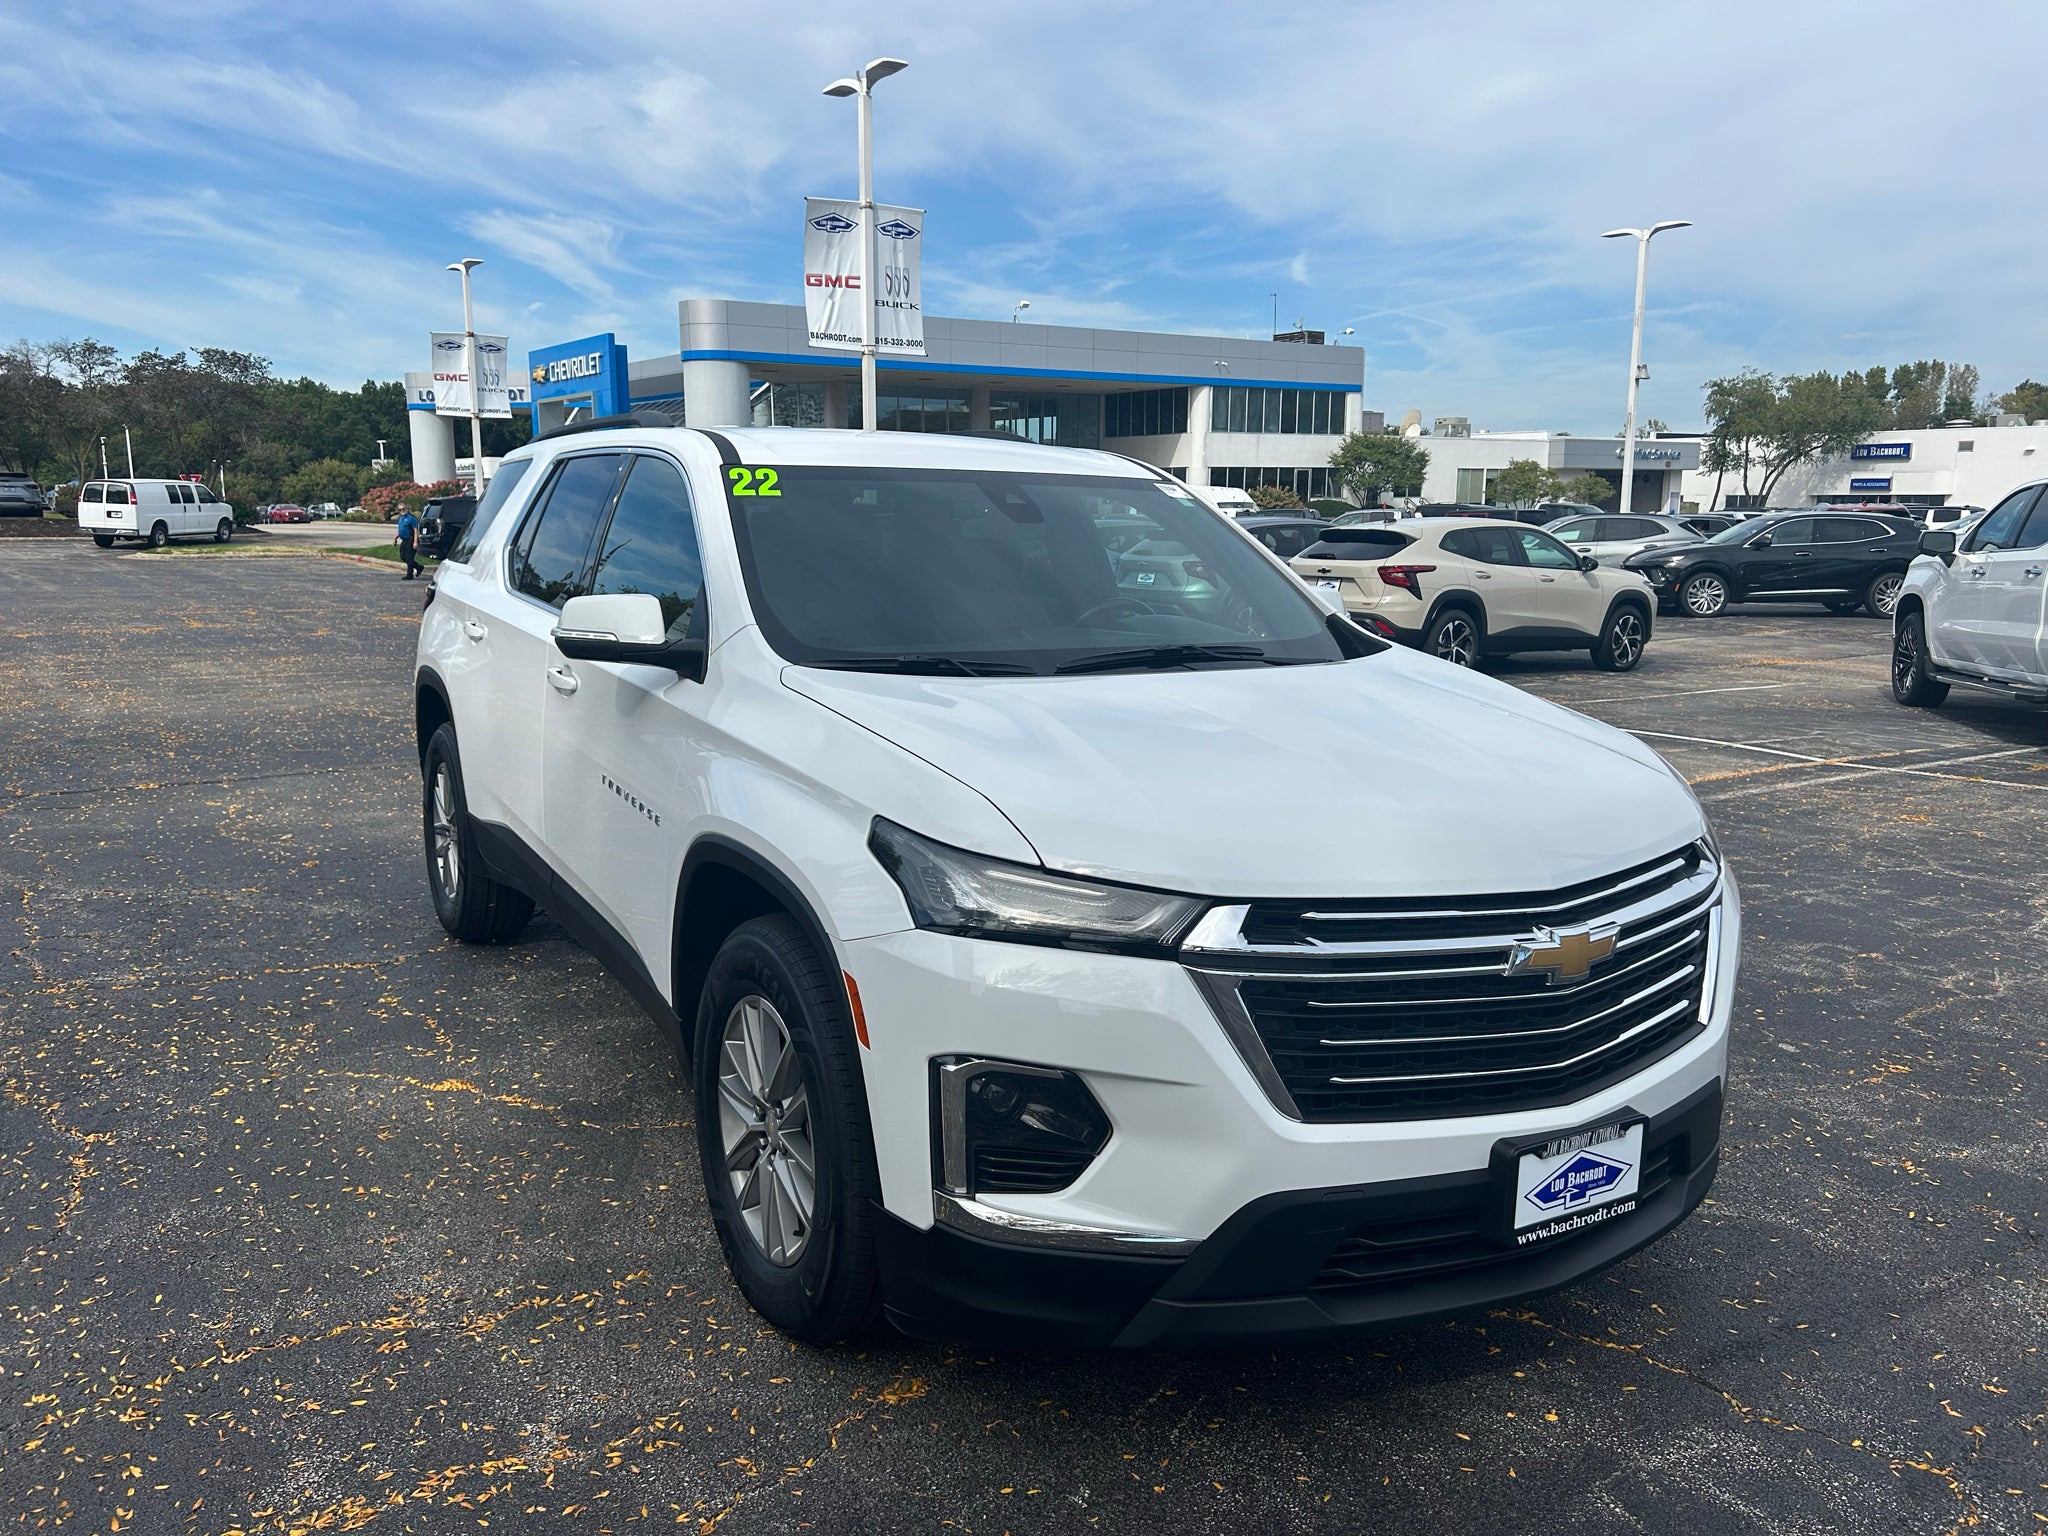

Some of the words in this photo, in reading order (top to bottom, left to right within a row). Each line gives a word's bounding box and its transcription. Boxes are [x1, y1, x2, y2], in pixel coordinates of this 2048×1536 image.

[805, 273, 861, 289] GMC
[875, 300, 920, 310] BUICK
[810, 331, 862, 344] BACHRODT.com
[875, 337, 923, 348] 815-332-3000
[549, 352, 602, 382] CHEVROLET
[433, 373, 469, 382] GMC
[418, 390, 435, 402] LO
[1856, 449, 1868, 457] LOU
[728, 467, 782, 497] 22
[602, 774, 661, 827] TRAVERSE
[1547, 1141, 1560, 1157] LOU
[1550, 1177, 1565, 1192] LOU
[1567, 1165, 1608, 1188] BACHRODT
[1517, 1200, 1636, 1245] www.bachrodt.com
